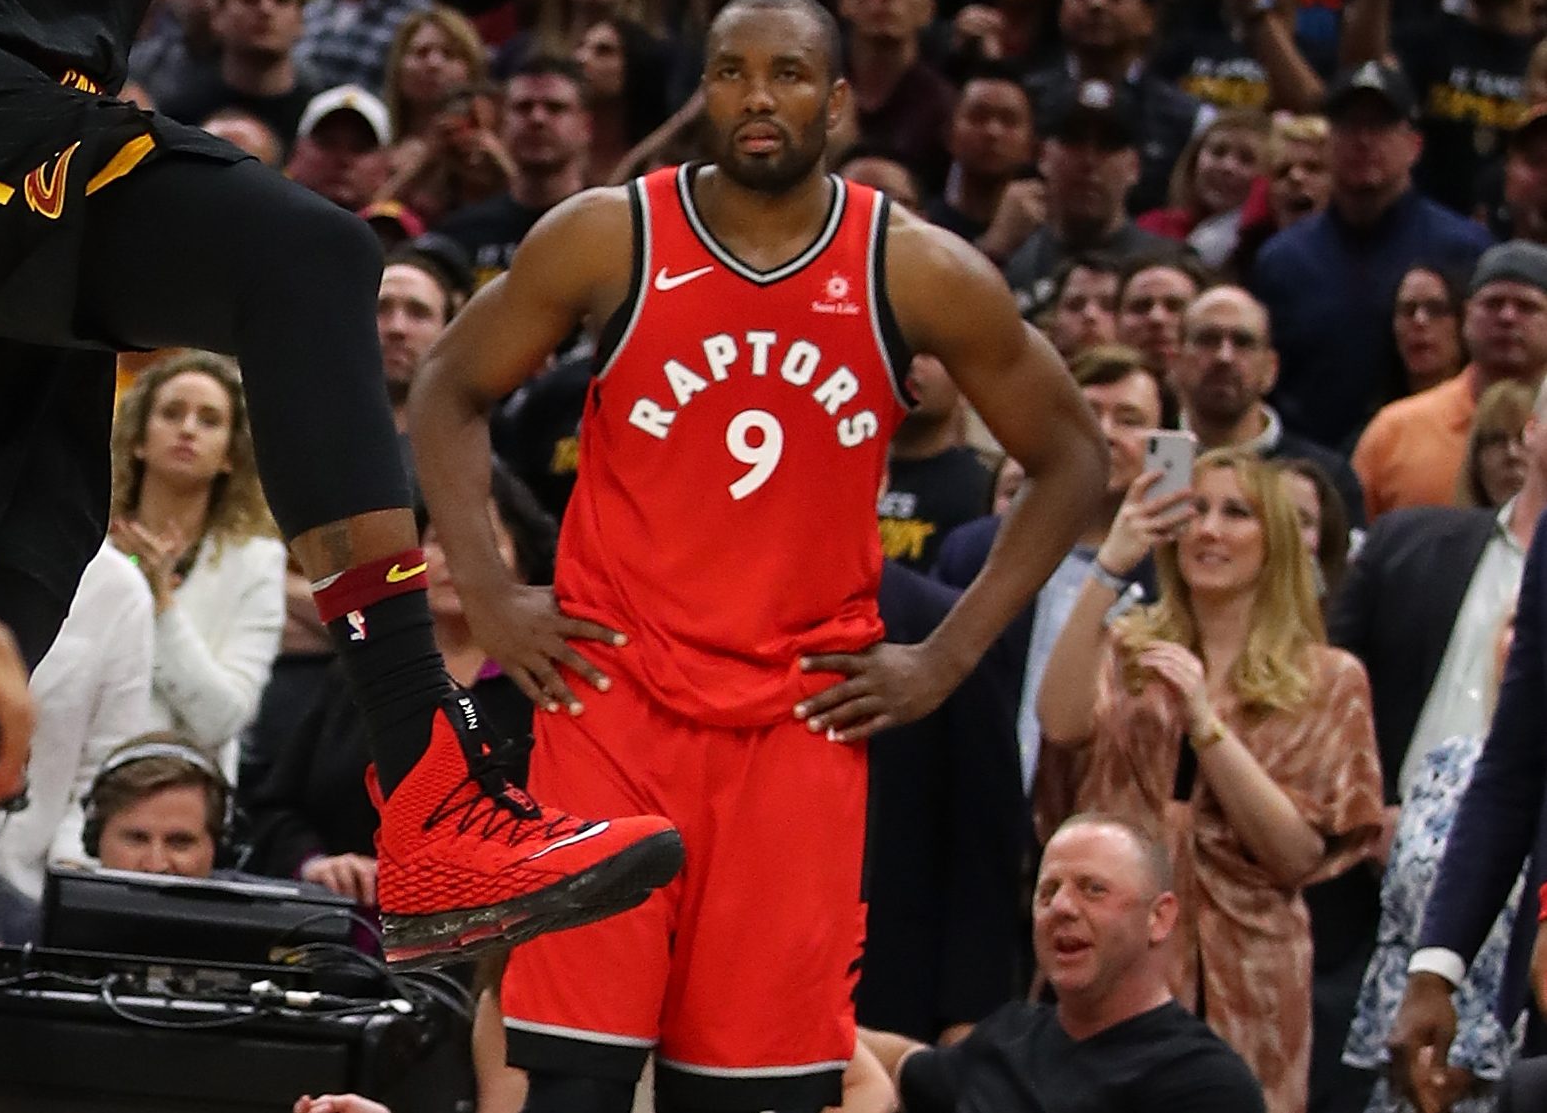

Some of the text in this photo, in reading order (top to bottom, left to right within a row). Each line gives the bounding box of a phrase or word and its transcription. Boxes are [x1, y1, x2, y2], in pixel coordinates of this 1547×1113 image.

[628, 331, 879, 449] RAPTORS
[725, 409, 784, 501] 9
[458, 697, 478, 729] NIKE
